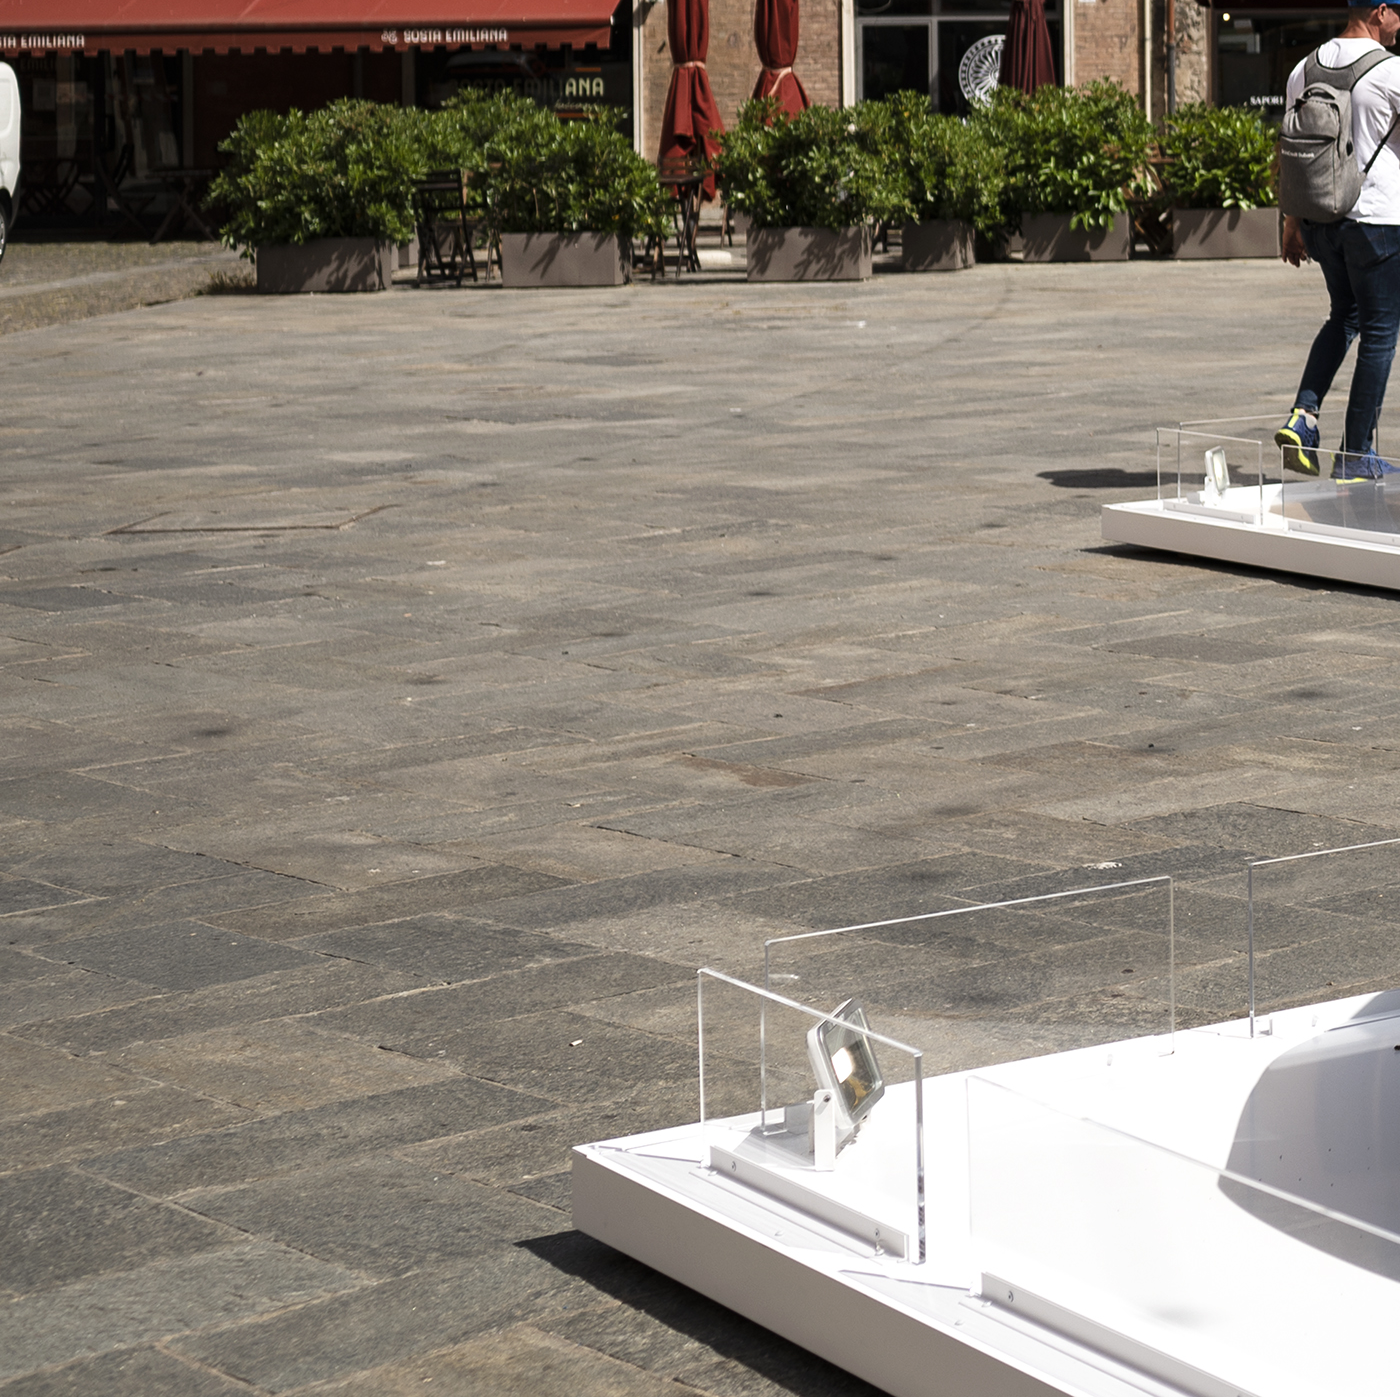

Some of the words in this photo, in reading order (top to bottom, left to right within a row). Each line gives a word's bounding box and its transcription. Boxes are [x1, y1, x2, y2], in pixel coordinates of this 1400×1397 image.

[20, 34, 85, 48] EMILIANA
[404, 29, 442, 43] SOSTA
[445, 28, 508, 43] EMILIANA
[1250, 95, 1284, 106] SAPORI
